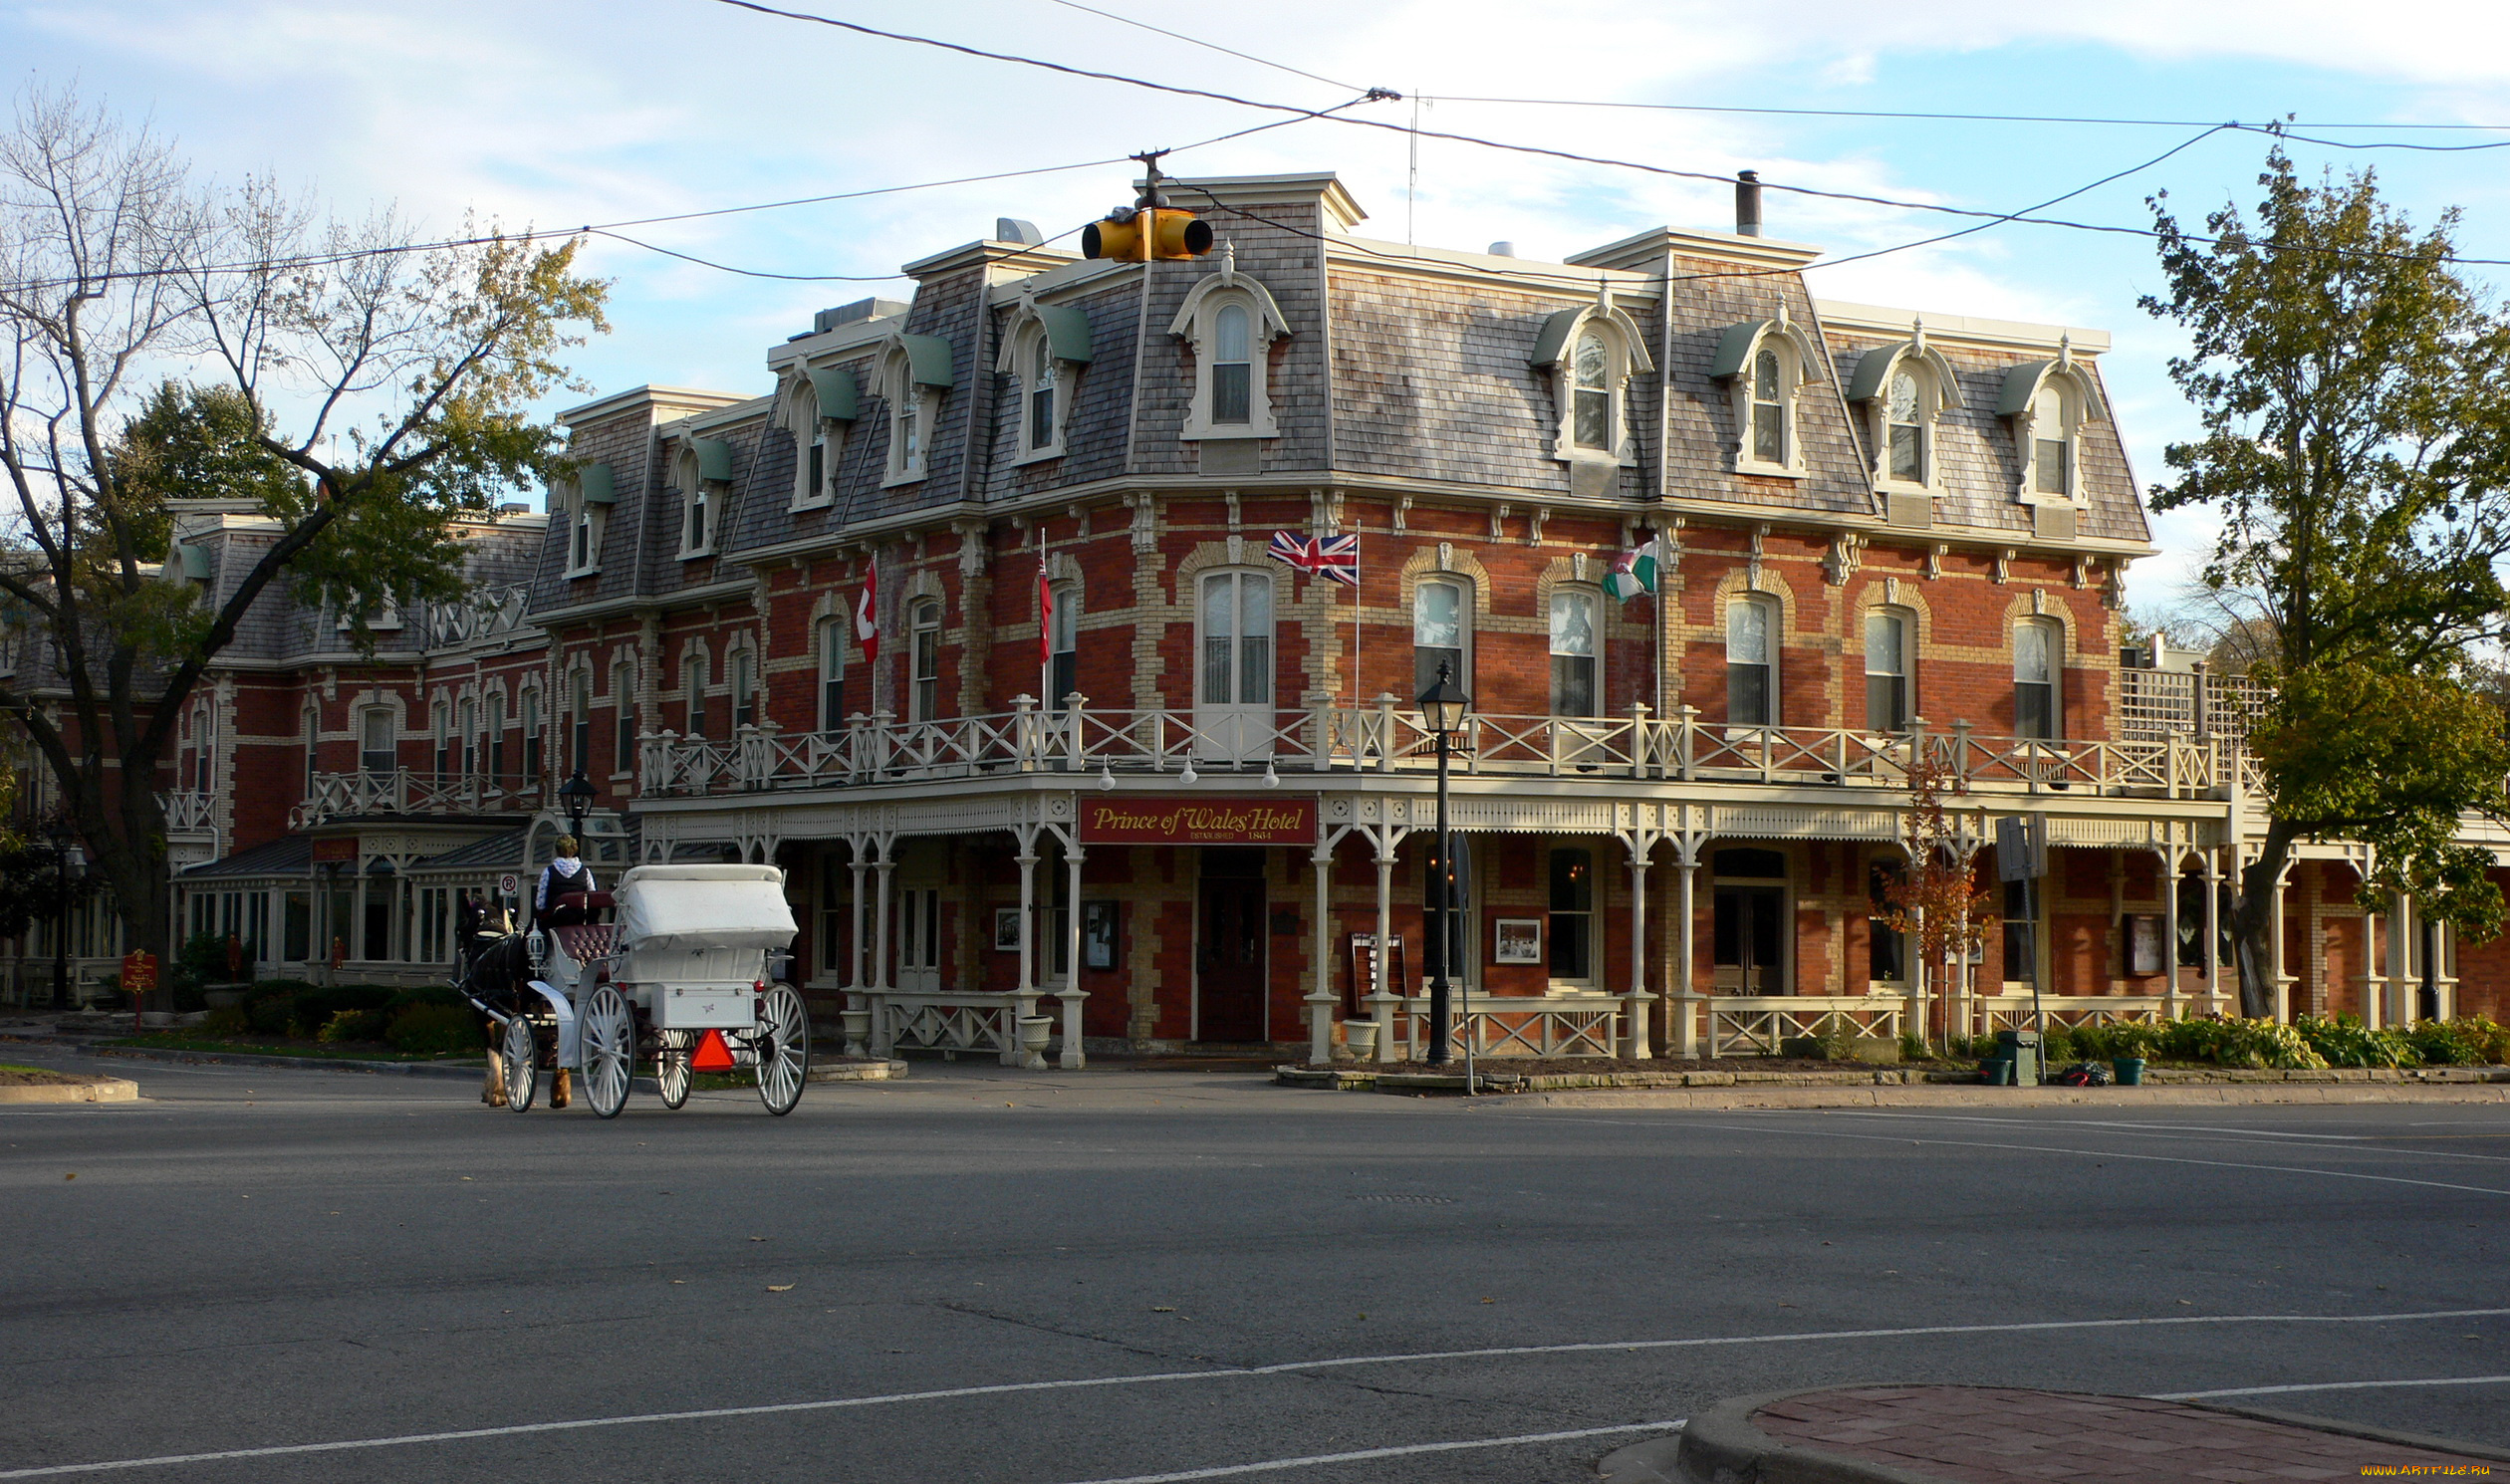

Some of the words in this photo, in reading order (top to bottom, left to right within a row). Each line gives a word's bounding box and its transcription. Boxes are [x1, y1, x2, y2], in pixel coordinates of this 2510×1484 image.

[1094, 808, 1157, 830] Prince
[1160, 807, 1185, 835] of
[1185, 808, 1247, 832] Wales
[1248, 808, 1303, 830] Hotel
